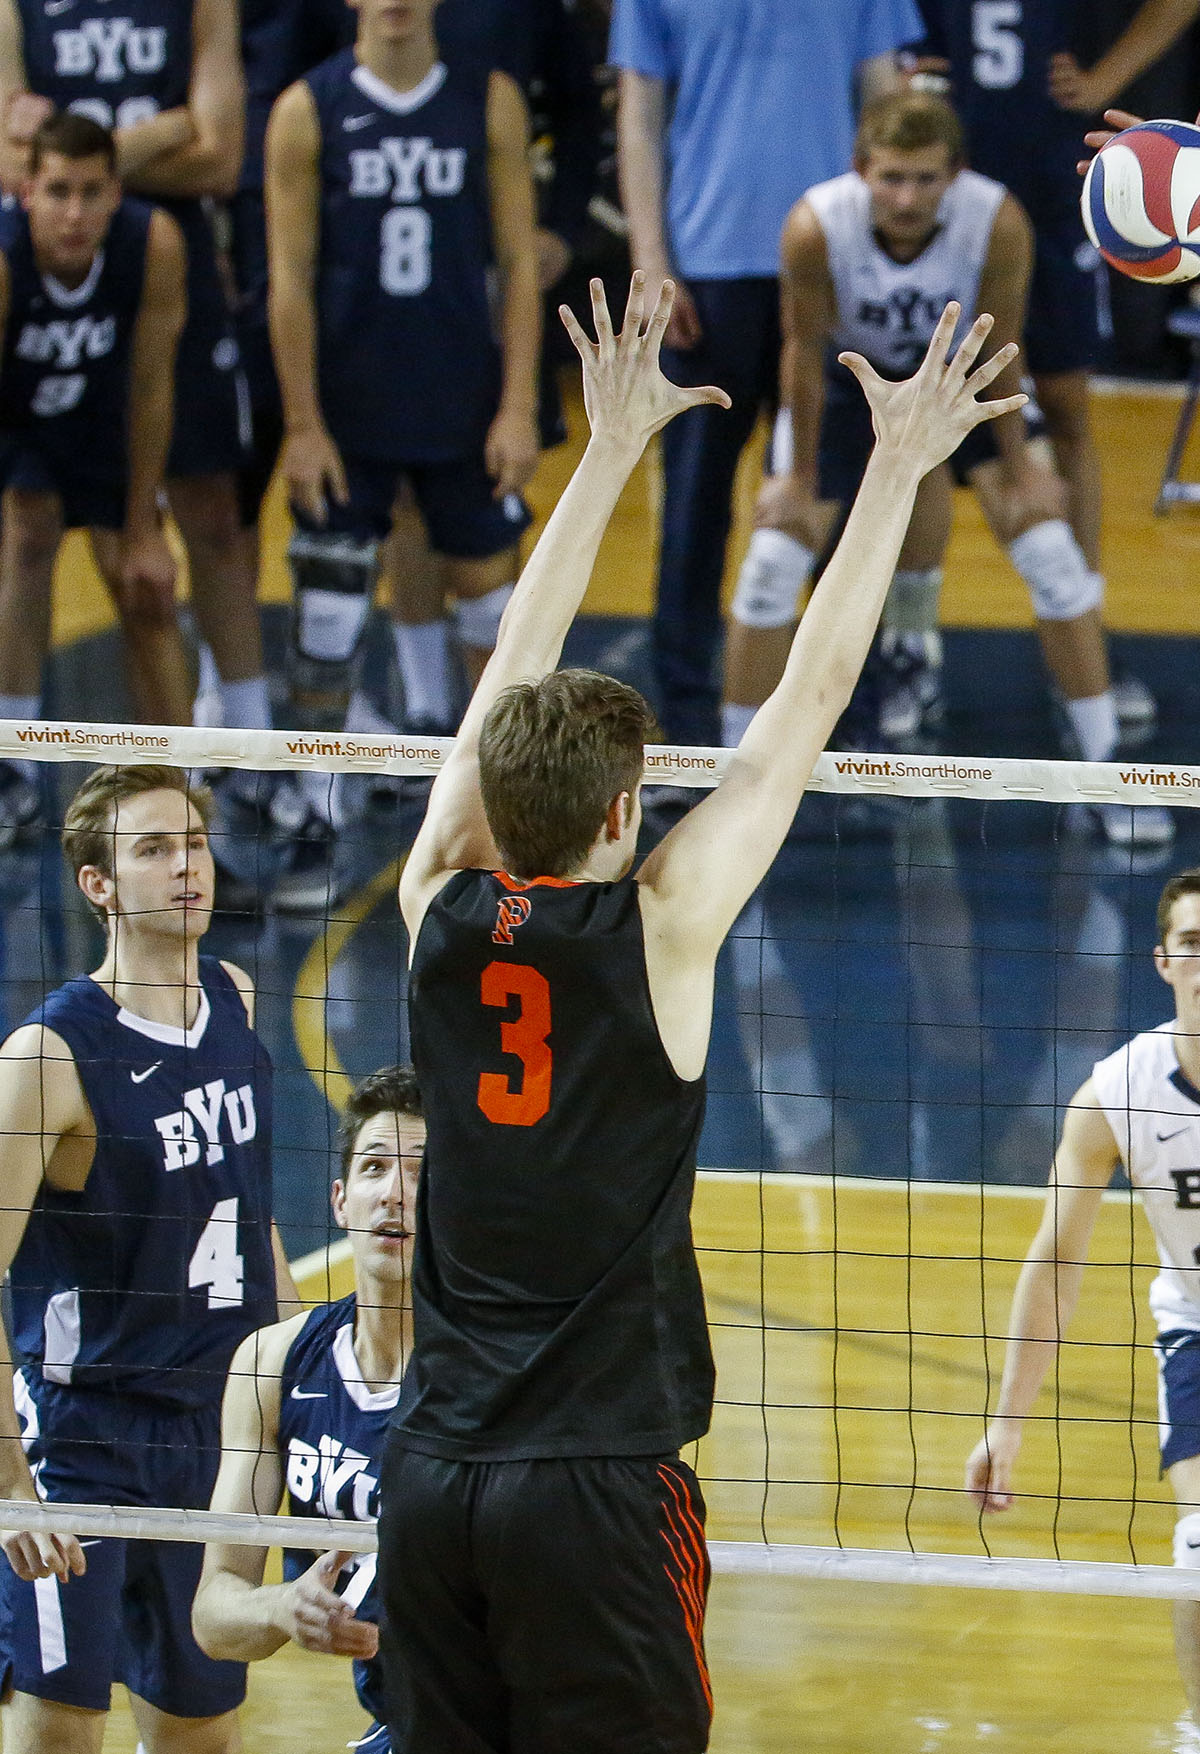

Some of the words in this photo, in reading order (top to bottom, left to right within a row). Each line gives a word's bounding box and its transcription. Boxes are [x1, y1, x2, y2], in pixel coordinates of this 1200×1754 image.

[53, 17, 167, 82] BYU
[972, 0, 1024, 89] 5
[348, 136, 467, 203] BYU
[379, 205, 433, 296] 8
[491, 895, 532, 945] P
[476, 960, 553, 1127] 3
[154, 1078, 258, 1172] BYU
[188, 1197, 244, 1310] 4
[287, 1433, 382, 1523] BYU
